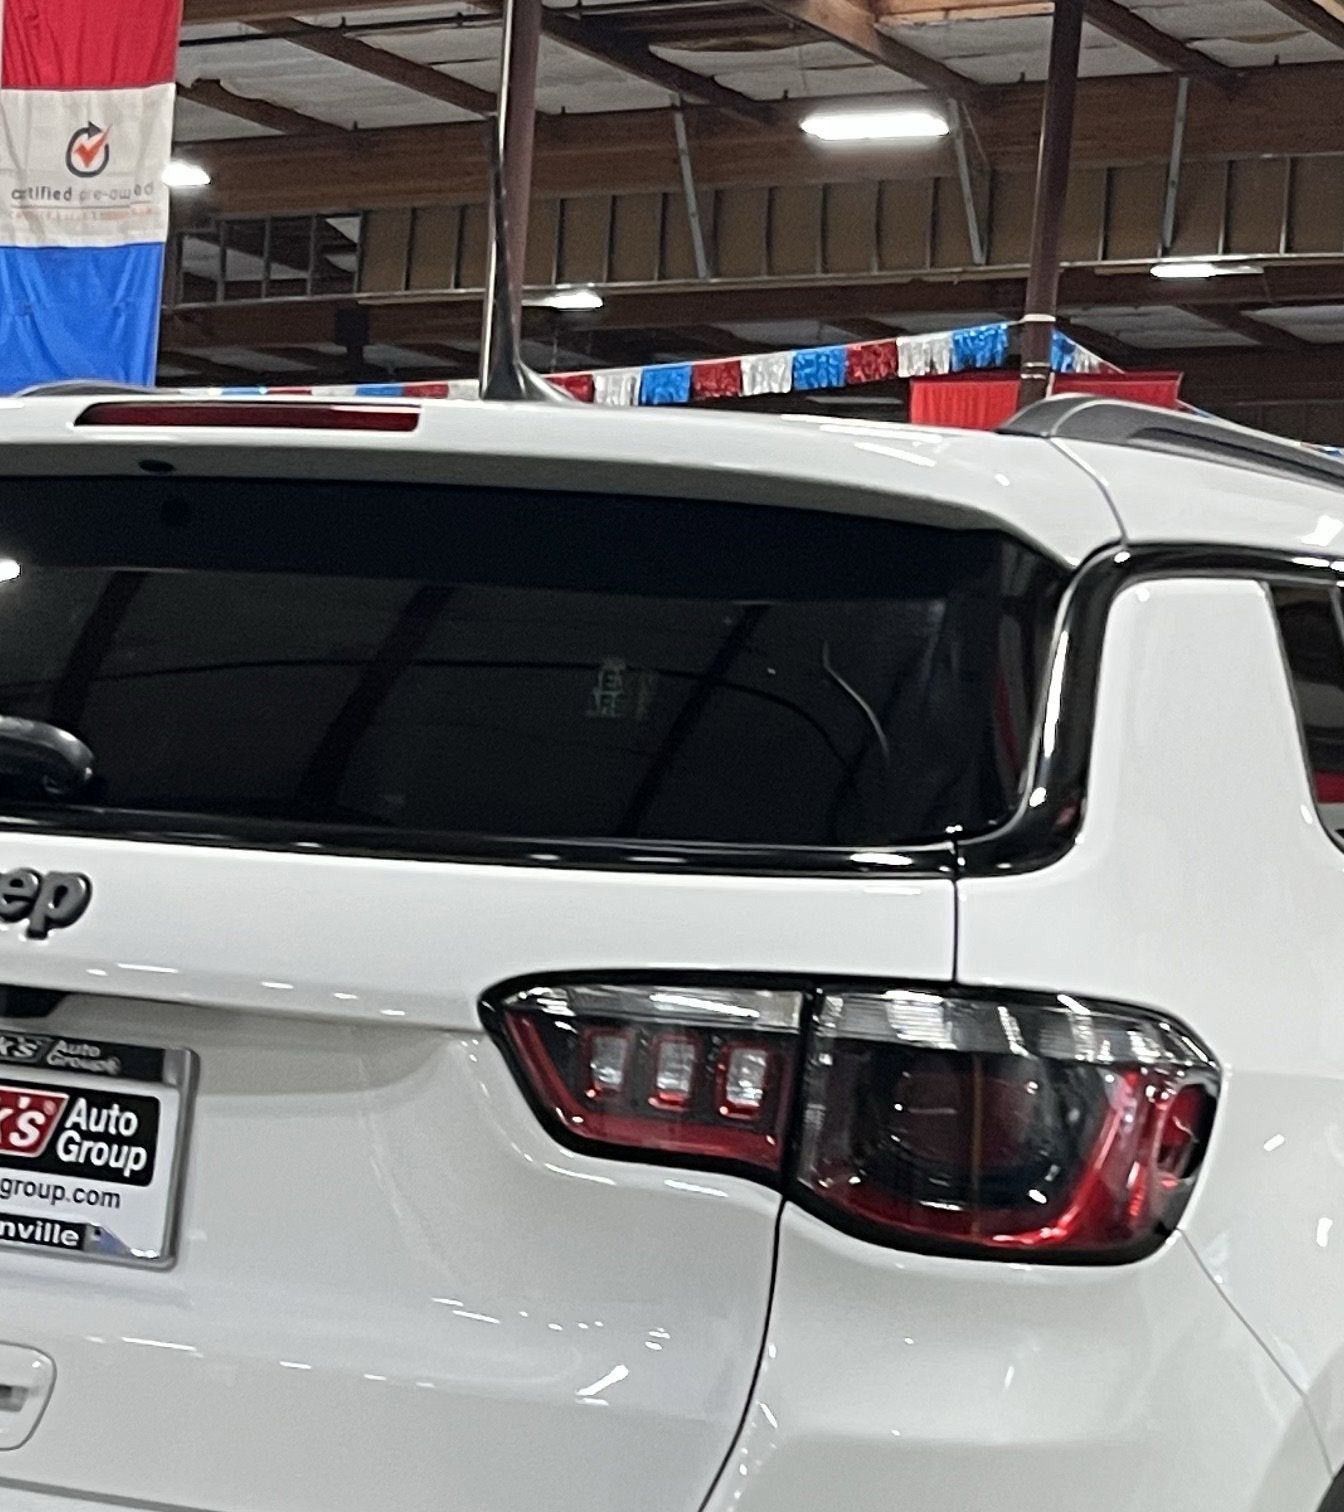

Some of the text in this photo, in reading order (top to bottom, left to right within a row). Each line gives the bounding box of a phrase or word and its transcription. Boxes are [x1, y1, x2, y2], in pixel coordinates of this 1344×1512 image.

[54, 1040, 101, 1057] Auto
[64, 1097, 138, 1136] Auto
[57, 1131, 147, 1177] Group
